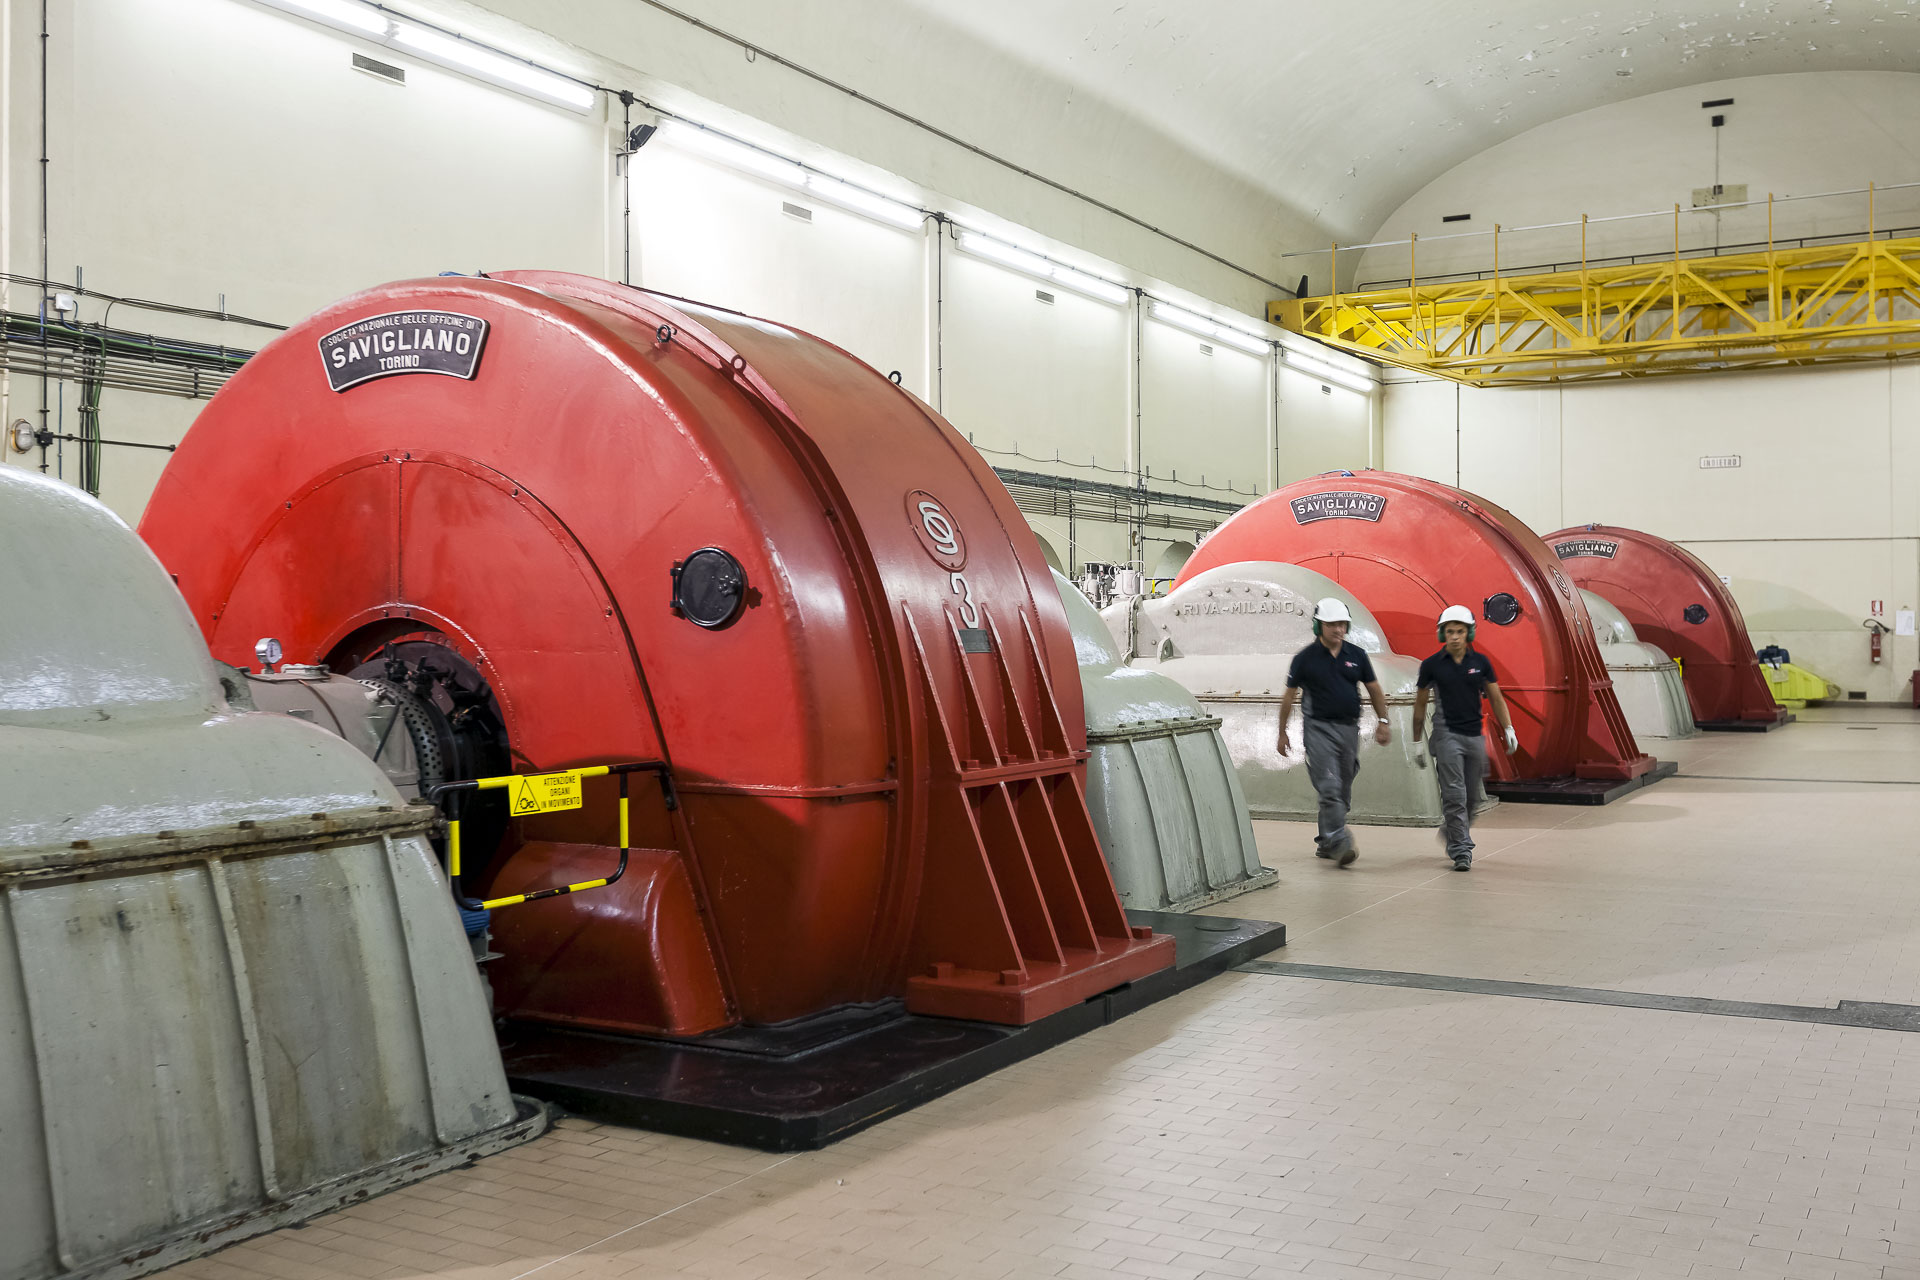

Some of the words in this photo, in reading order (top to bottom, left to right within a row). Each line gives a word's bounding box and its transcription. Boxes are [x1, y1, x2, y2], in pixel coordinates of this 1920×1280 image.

[359, 316, 400, 333] NAZIONALE
[403, 315, 428, 324] DELLE
[430, 315, 464, 328] OFFICINE
[466, 320, 475, 330] DI
[331, 328, 471, 369] SAVIGLIANO
[379, 354, 420, 371] TORINO
[1297, 498, 1377, 515] SAVIGLIANO
[1558, 544, 1613, 554] SAVIGLIANO
[951, 572, 979, 629] 3
[1183, 601, 1296, 616] RIVA-MILANO
[544, 775, 575, 786] ATTENZIONE
[541, 800, 547, 809] IN
[548, 796, 579, 808] MOVIMENTO
